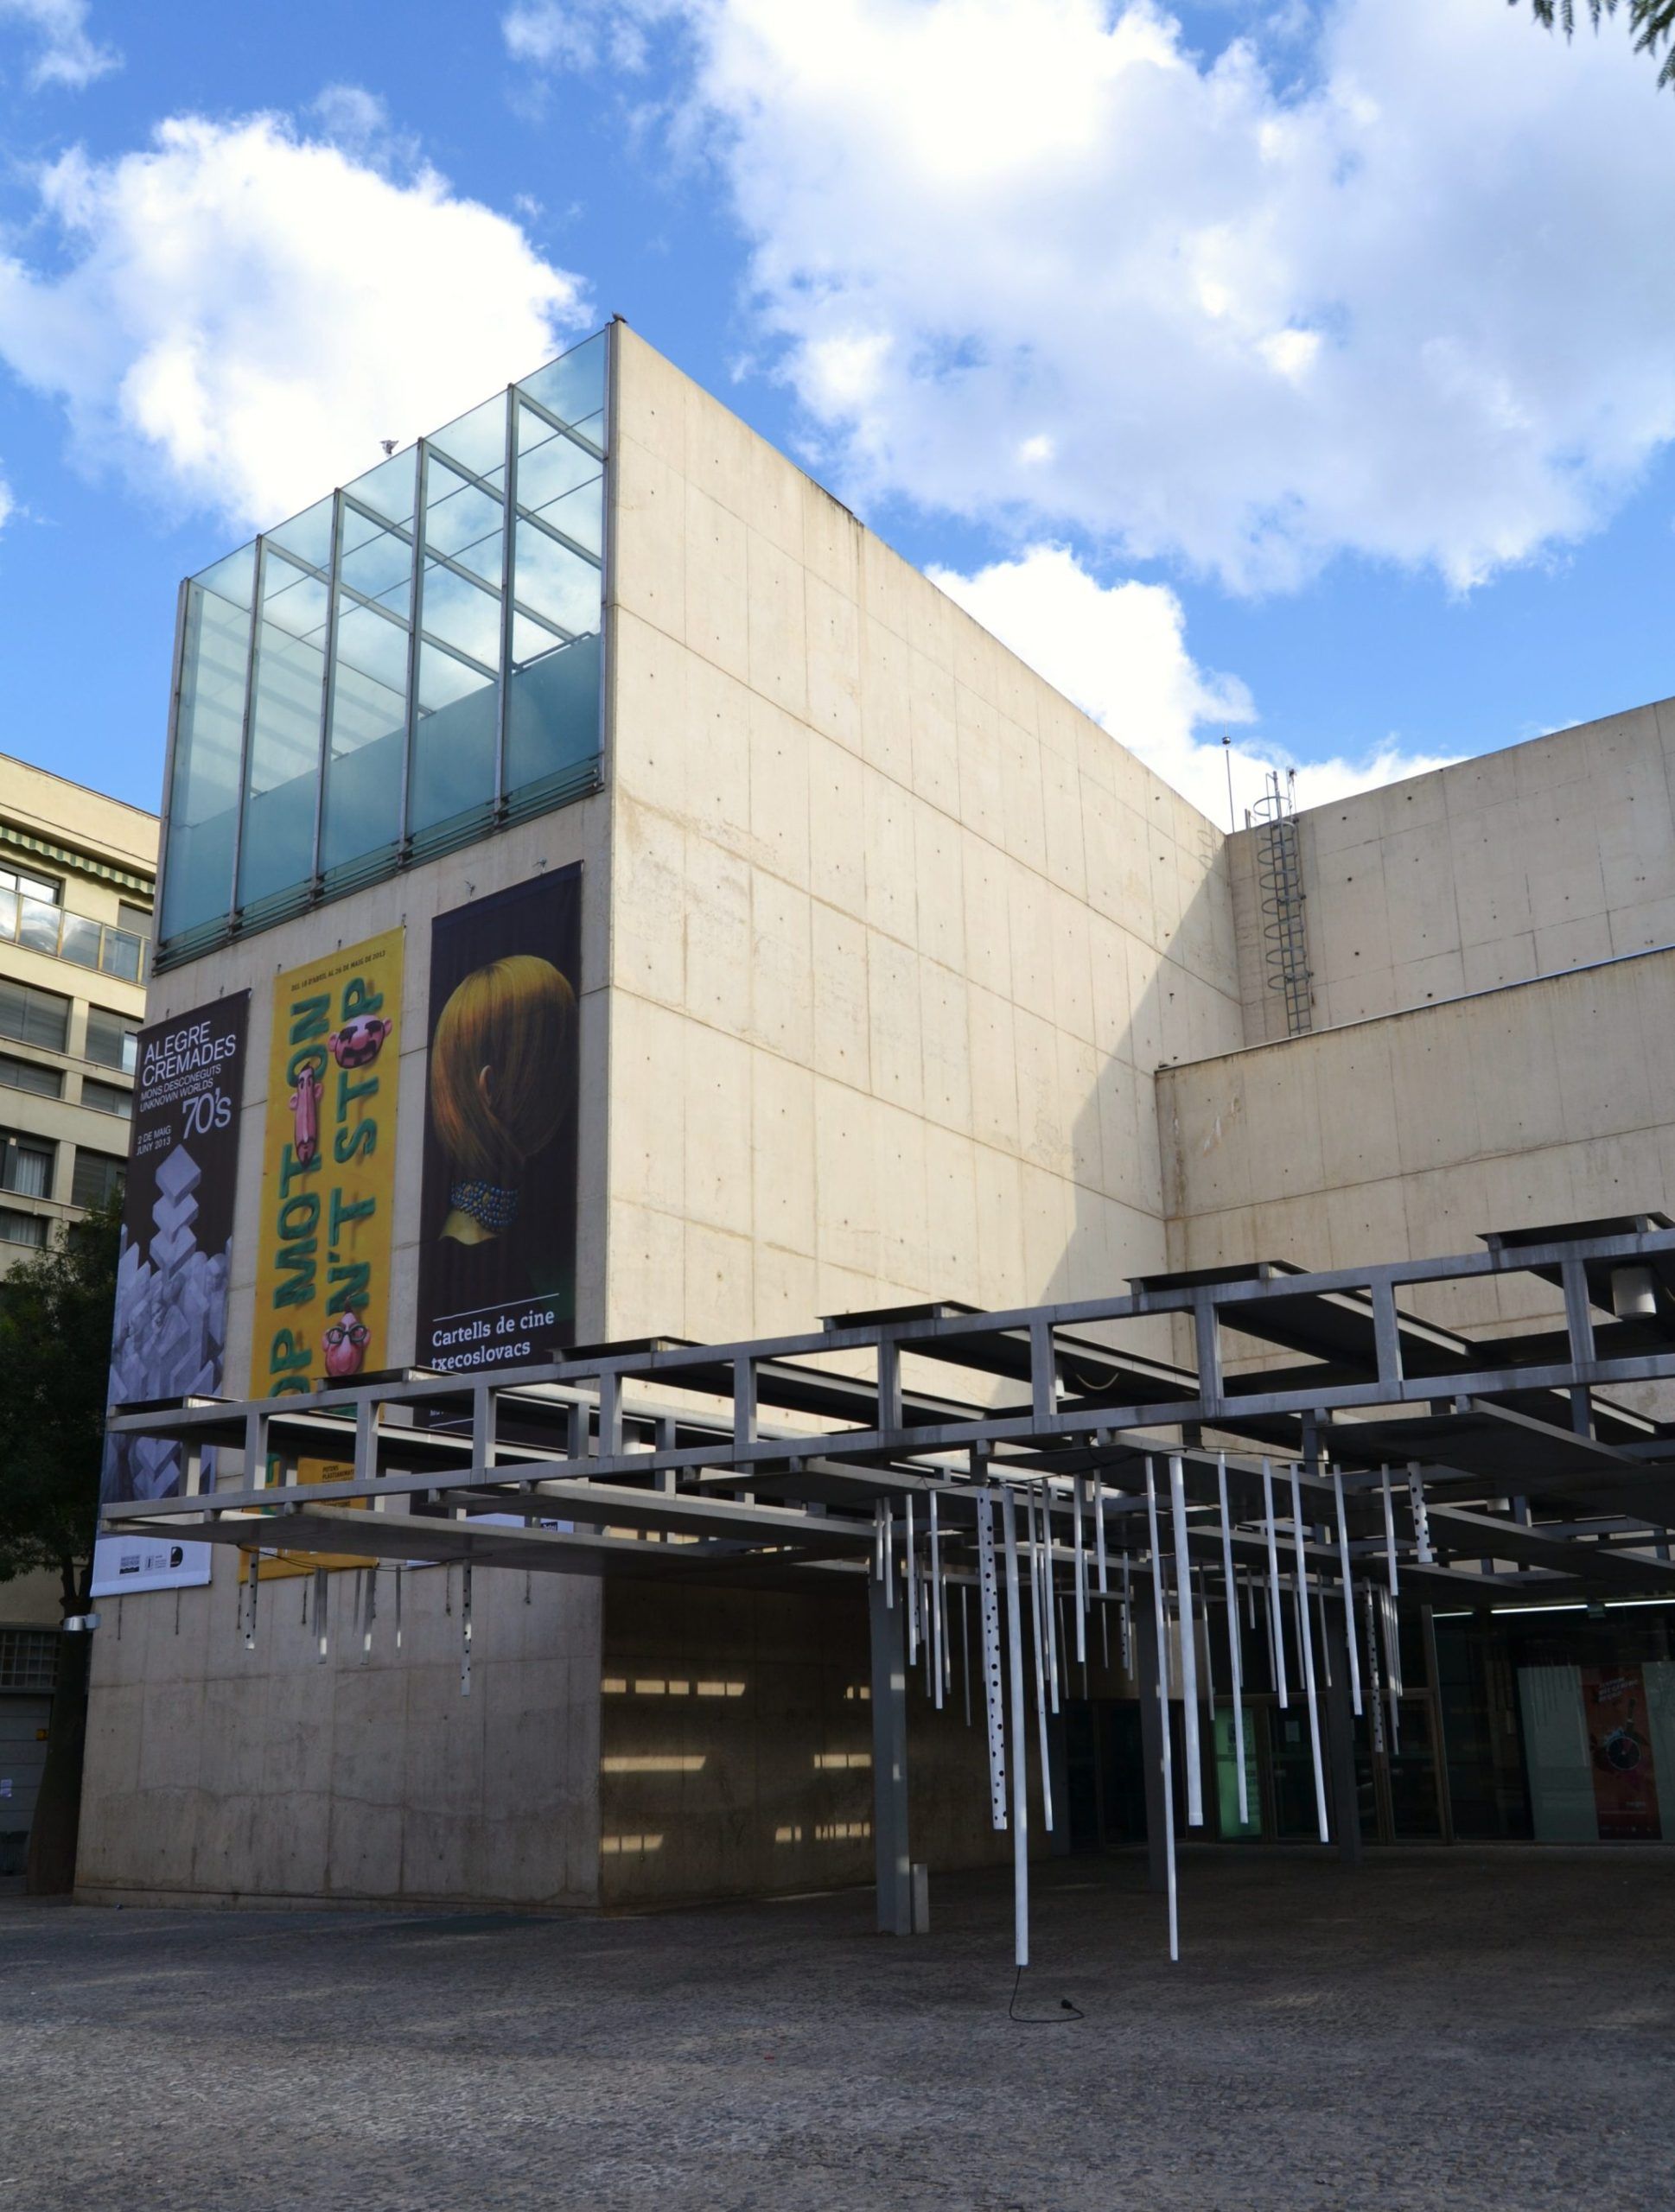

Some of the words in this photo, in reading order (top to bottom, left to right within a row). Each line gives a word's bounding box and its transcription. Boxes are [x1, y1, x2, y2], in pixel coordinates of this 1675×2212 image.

[142, 1034, 236, 1087] CREMADES
[143, 1020, 211, 1065] ALEGRE
[139, 1092, 178, 1113] UNKNOWN
[179, 1078, 213, 1097] WORLDS
[140, 1084, 163, 1101] MONS
[164, 1063, 221, 1093] DESCONEGUTS
[136, 1141, 154, 1156] JUNY
[155, 1136, 171, 1149] 2013
[143, 1131, 152, 1142] DE
[154, 1125, 171, 1139] MAIG
[432, 1320, 491, 1347] Cartells
[496, 1316, 515, 1334] de
[519, 1310, 555, 1330] cine
[431, 1341, 531, 1371] txecoslovacs
